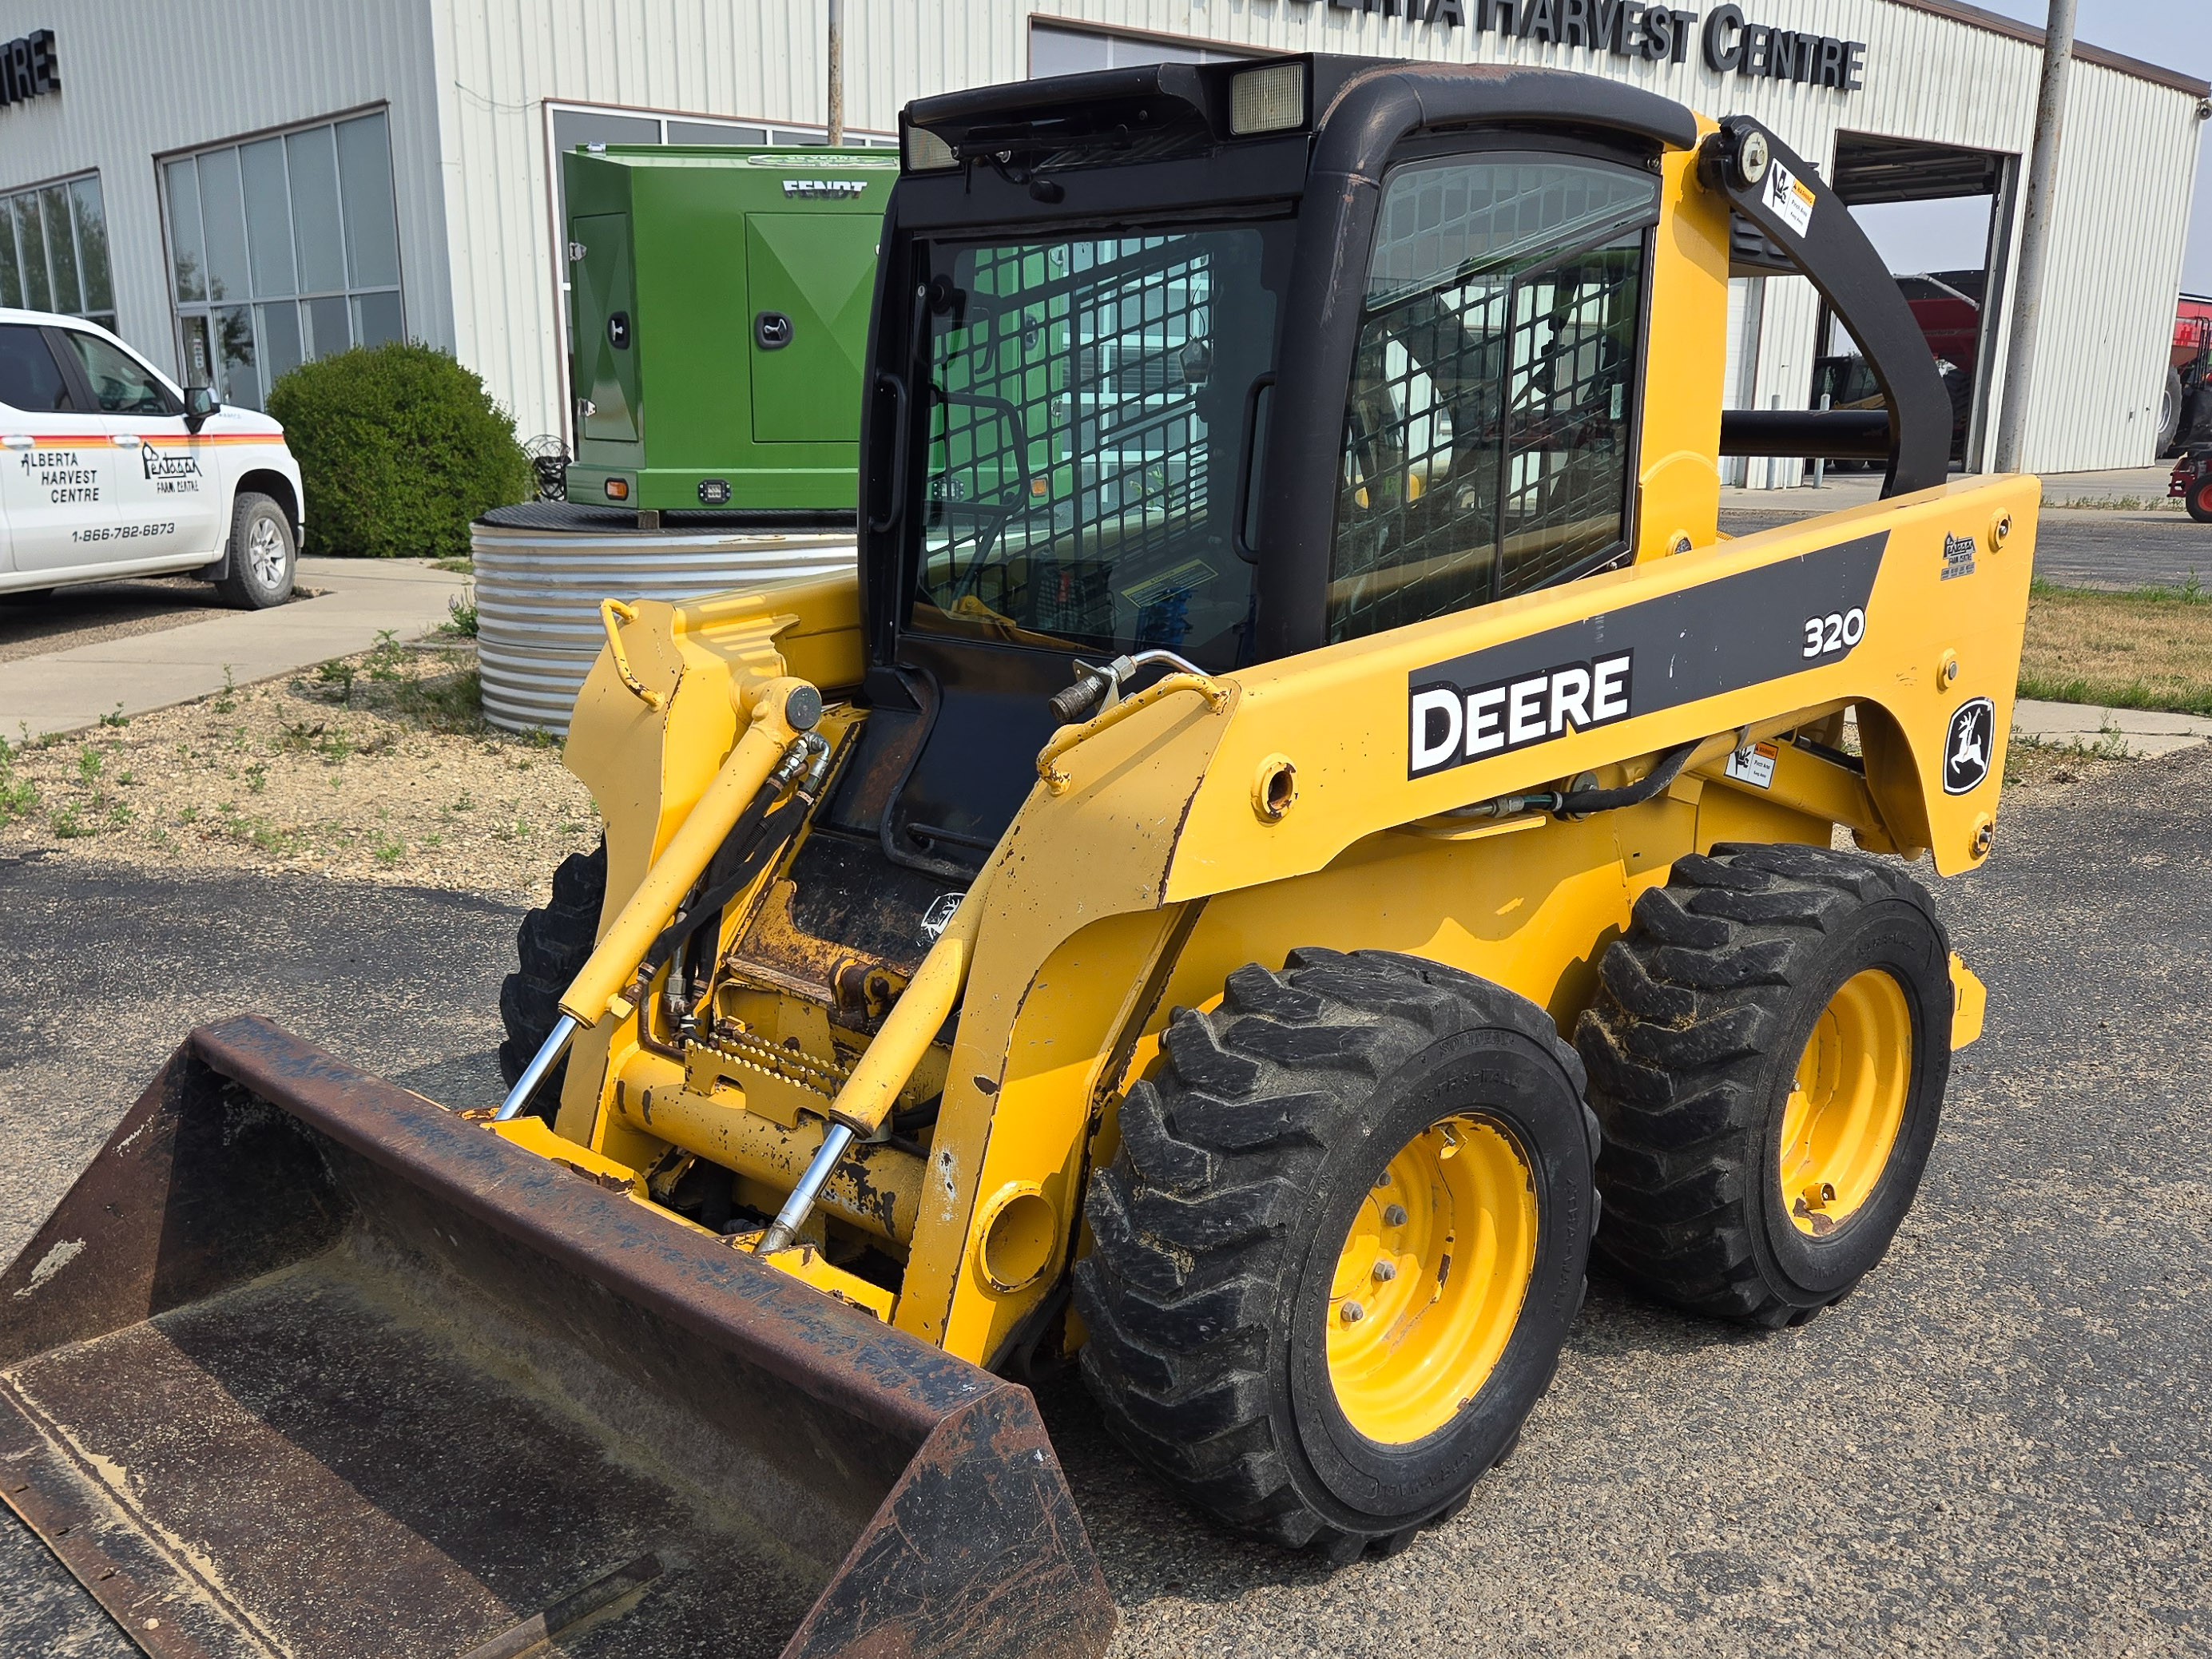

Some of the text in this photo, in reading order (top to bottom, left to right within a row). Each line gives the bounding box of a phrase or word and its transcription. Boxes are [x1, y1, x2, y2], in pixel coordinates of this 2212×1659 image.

[1704, 3, 1866, 90] CENTRE
[782, 180, 868, 199] FENDT
[21, 453, 78, 476] ALBERTA
[42, 470, 97, 486] HARVEST
[51, 488, 99, 503] CENTRE
[1803, 608, 1865, 657] 320
[1412, 656, 1630, 772] DEERE
